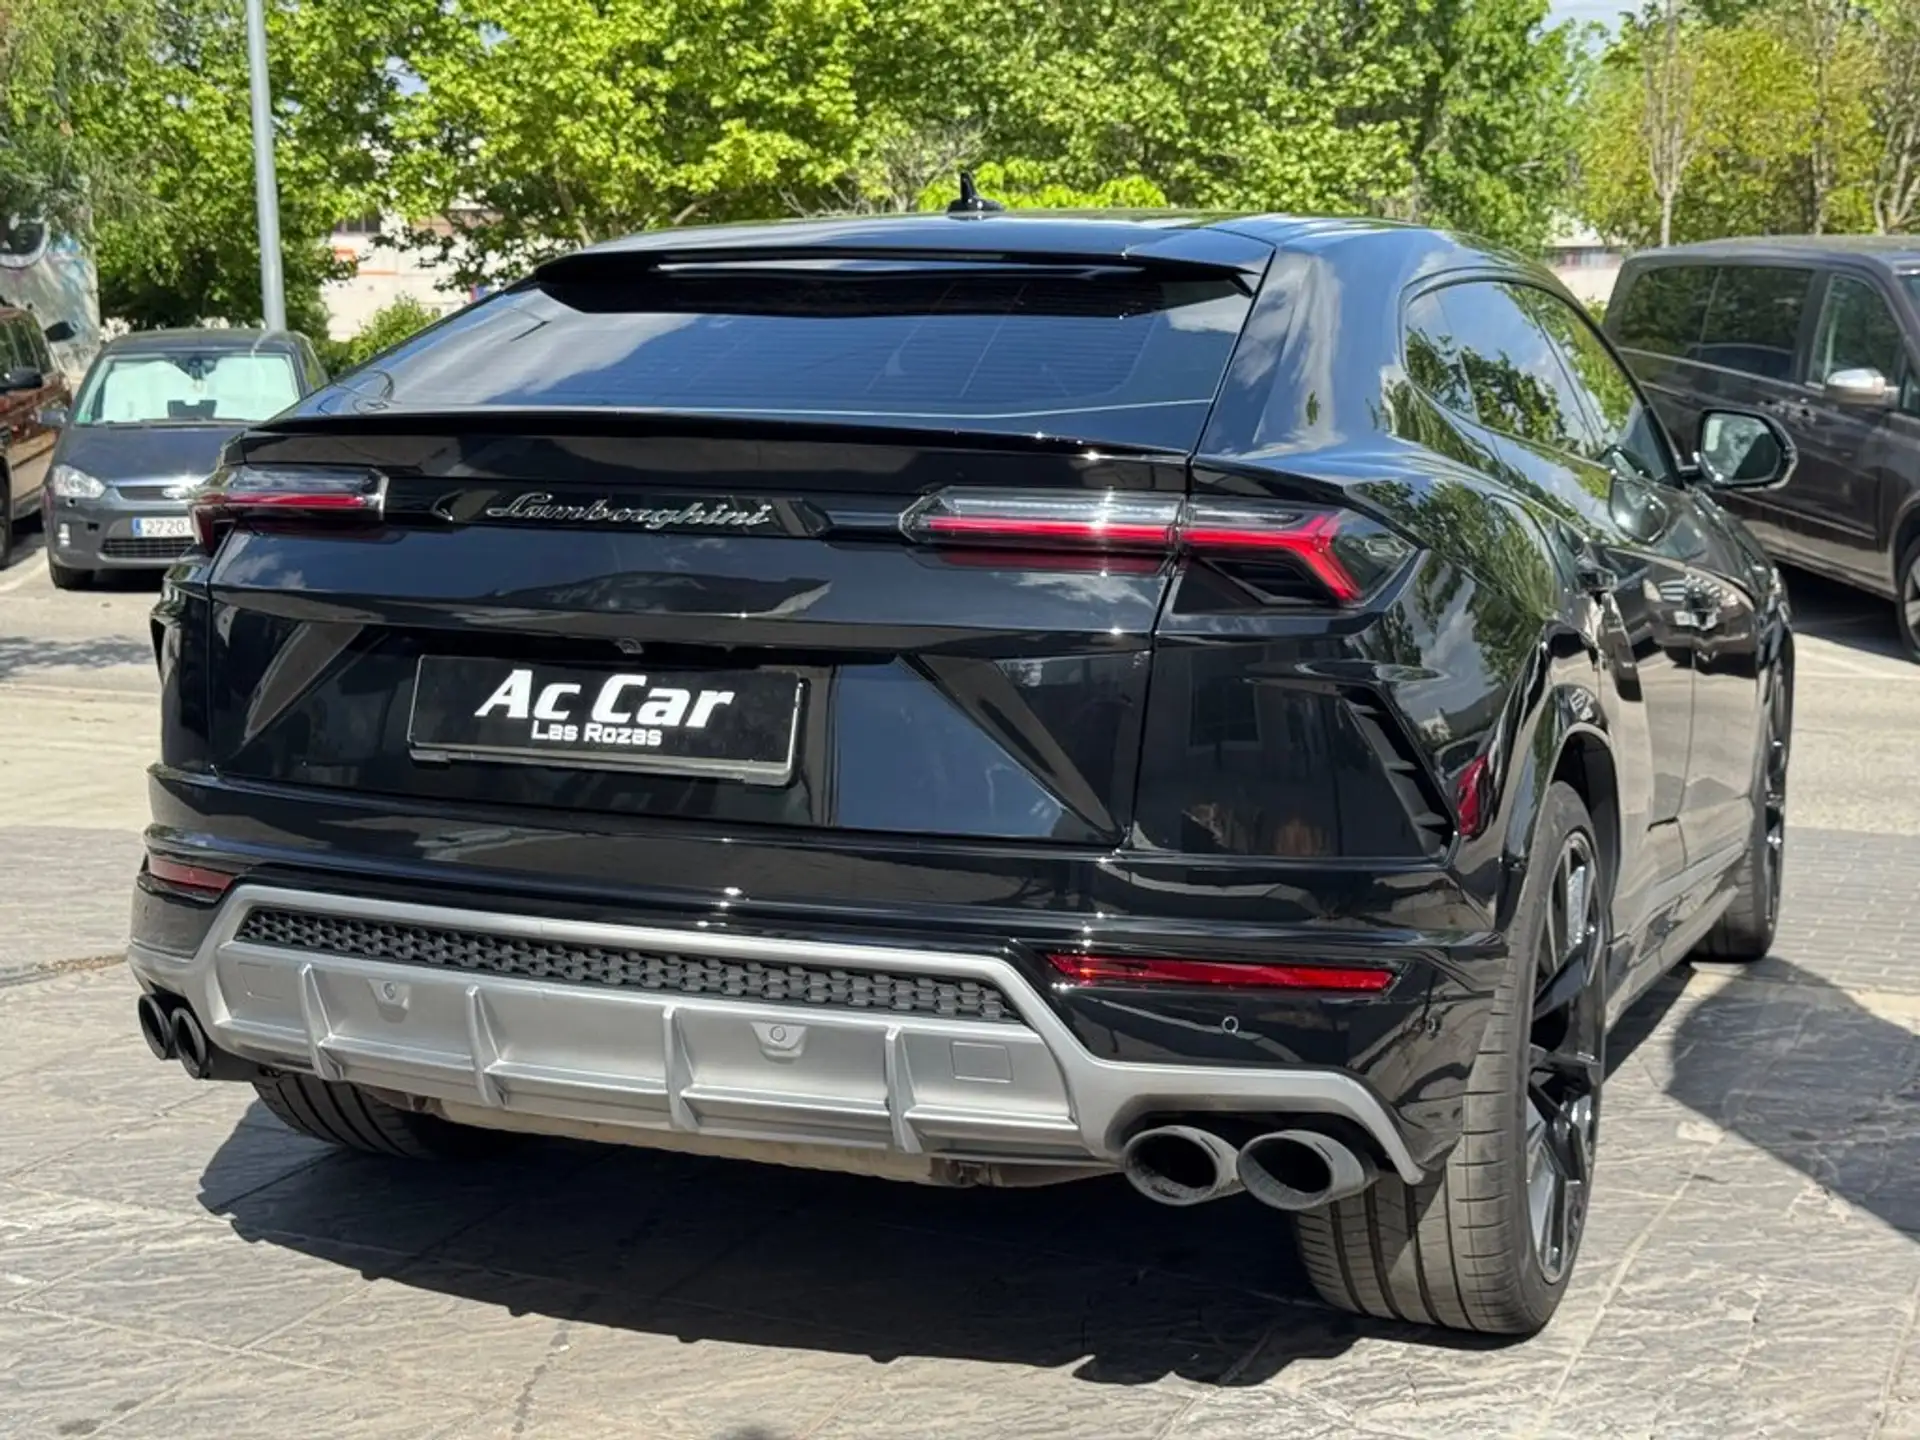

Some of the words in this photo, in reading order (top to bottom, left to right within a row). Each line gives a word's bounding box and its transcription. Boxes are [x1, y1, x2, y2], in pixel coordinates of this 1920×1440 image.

[485, 491, 774, 530] Lamborghini
[144, 519, 186, 536] 2720
[474, 669, 582, 721] Ac
[591, 673, 736, 729] Car
[530, 719, 579, 742] Las
[582, 720, 663, 747] Rozas
